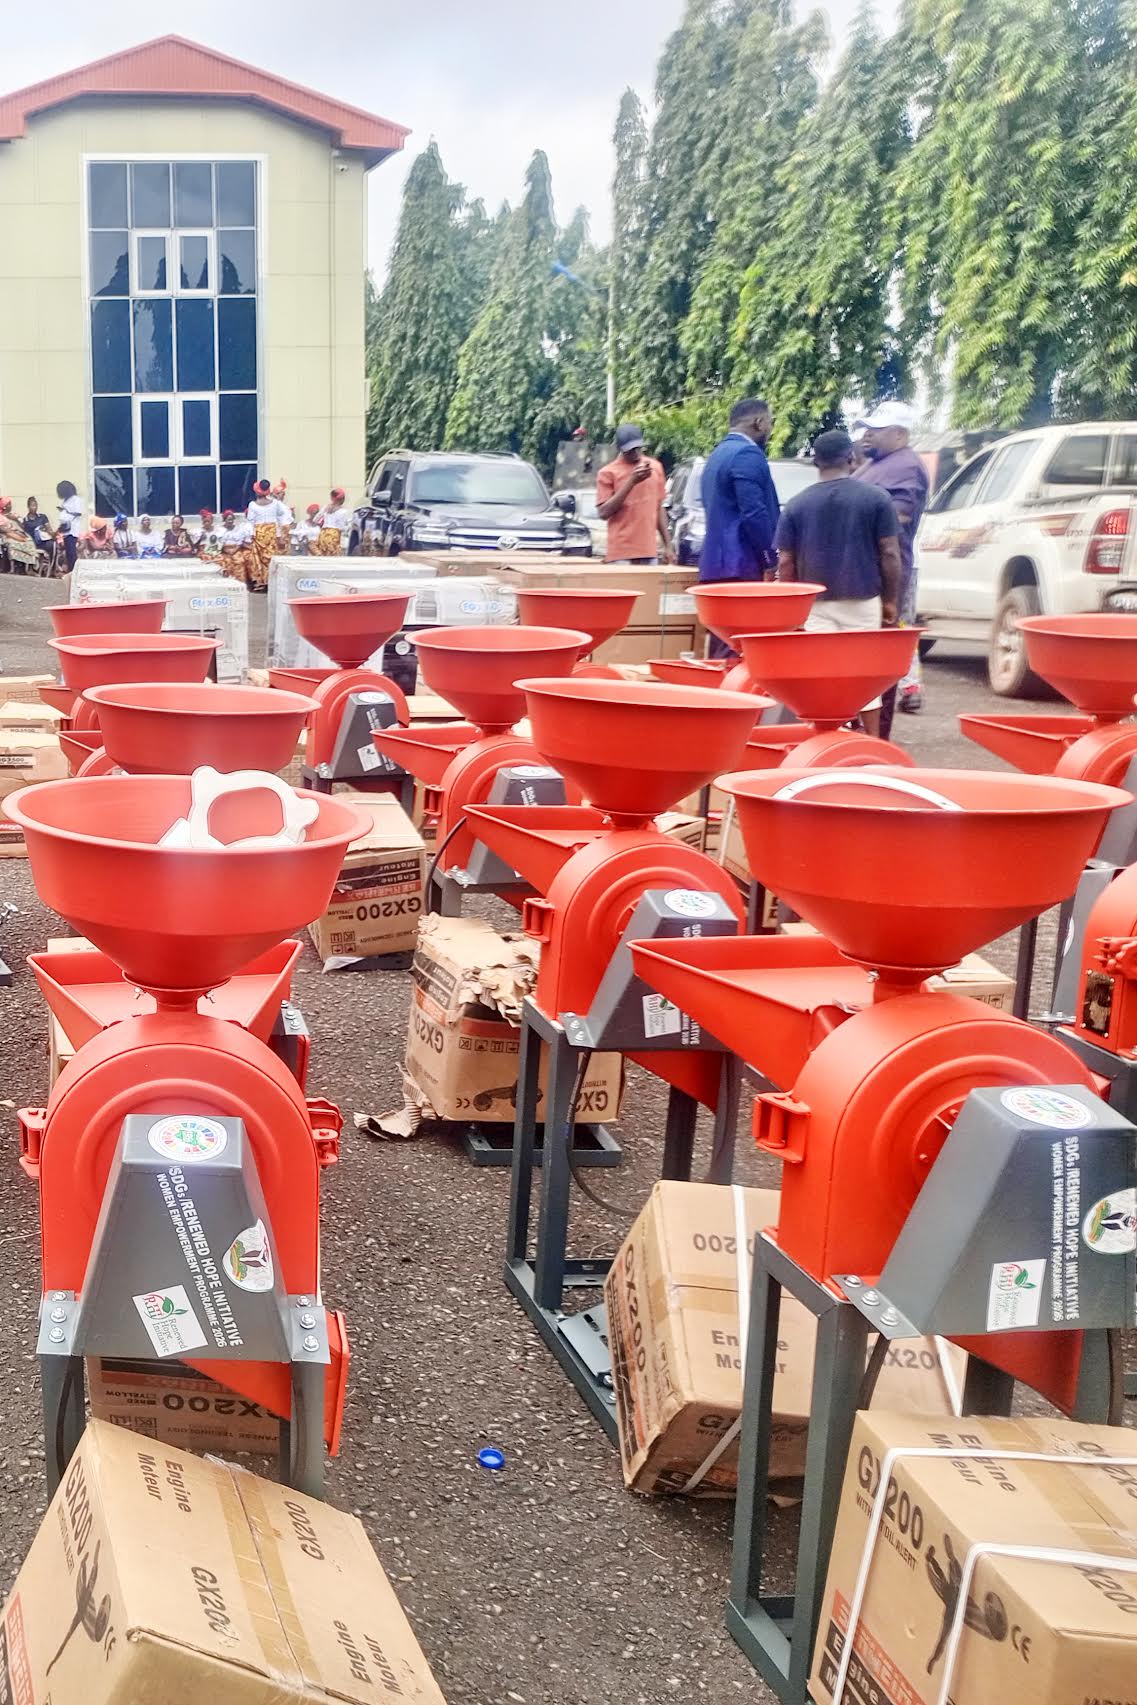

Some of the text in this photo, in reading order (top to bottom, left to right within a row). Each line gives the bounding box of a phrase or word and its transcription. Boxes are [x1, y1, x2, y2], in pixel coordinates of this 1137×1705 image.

[356, 896, 422, 921] GX200
[156, 1172, 228, 1348] WOMEN EMPOWERMENT PROGRAMME 2026
[1064, 1228, 1080, 1260] HOPE
[200, 1254, 223, 1289] HOPE
[212, 1289, 244, 1348] INITIATIVE
[1064, 1261, 1080, 1321] INITIATIVE
[160, 1320, 173, 1340] Hope
[136, 1451, 162, 1501] Moteur
[164, 1459, 192, 1514] Engine
[65, 1455, 93, 1557] GX200
[284, 1500, 325, 1561] GX200
[896, 1539, 918, 1571] ALERT
[332, 1619, 373, 1685] Engine
[364, 1633, 403, 1695] Moteur
[1011, 1624, 1033, 1664] CE
